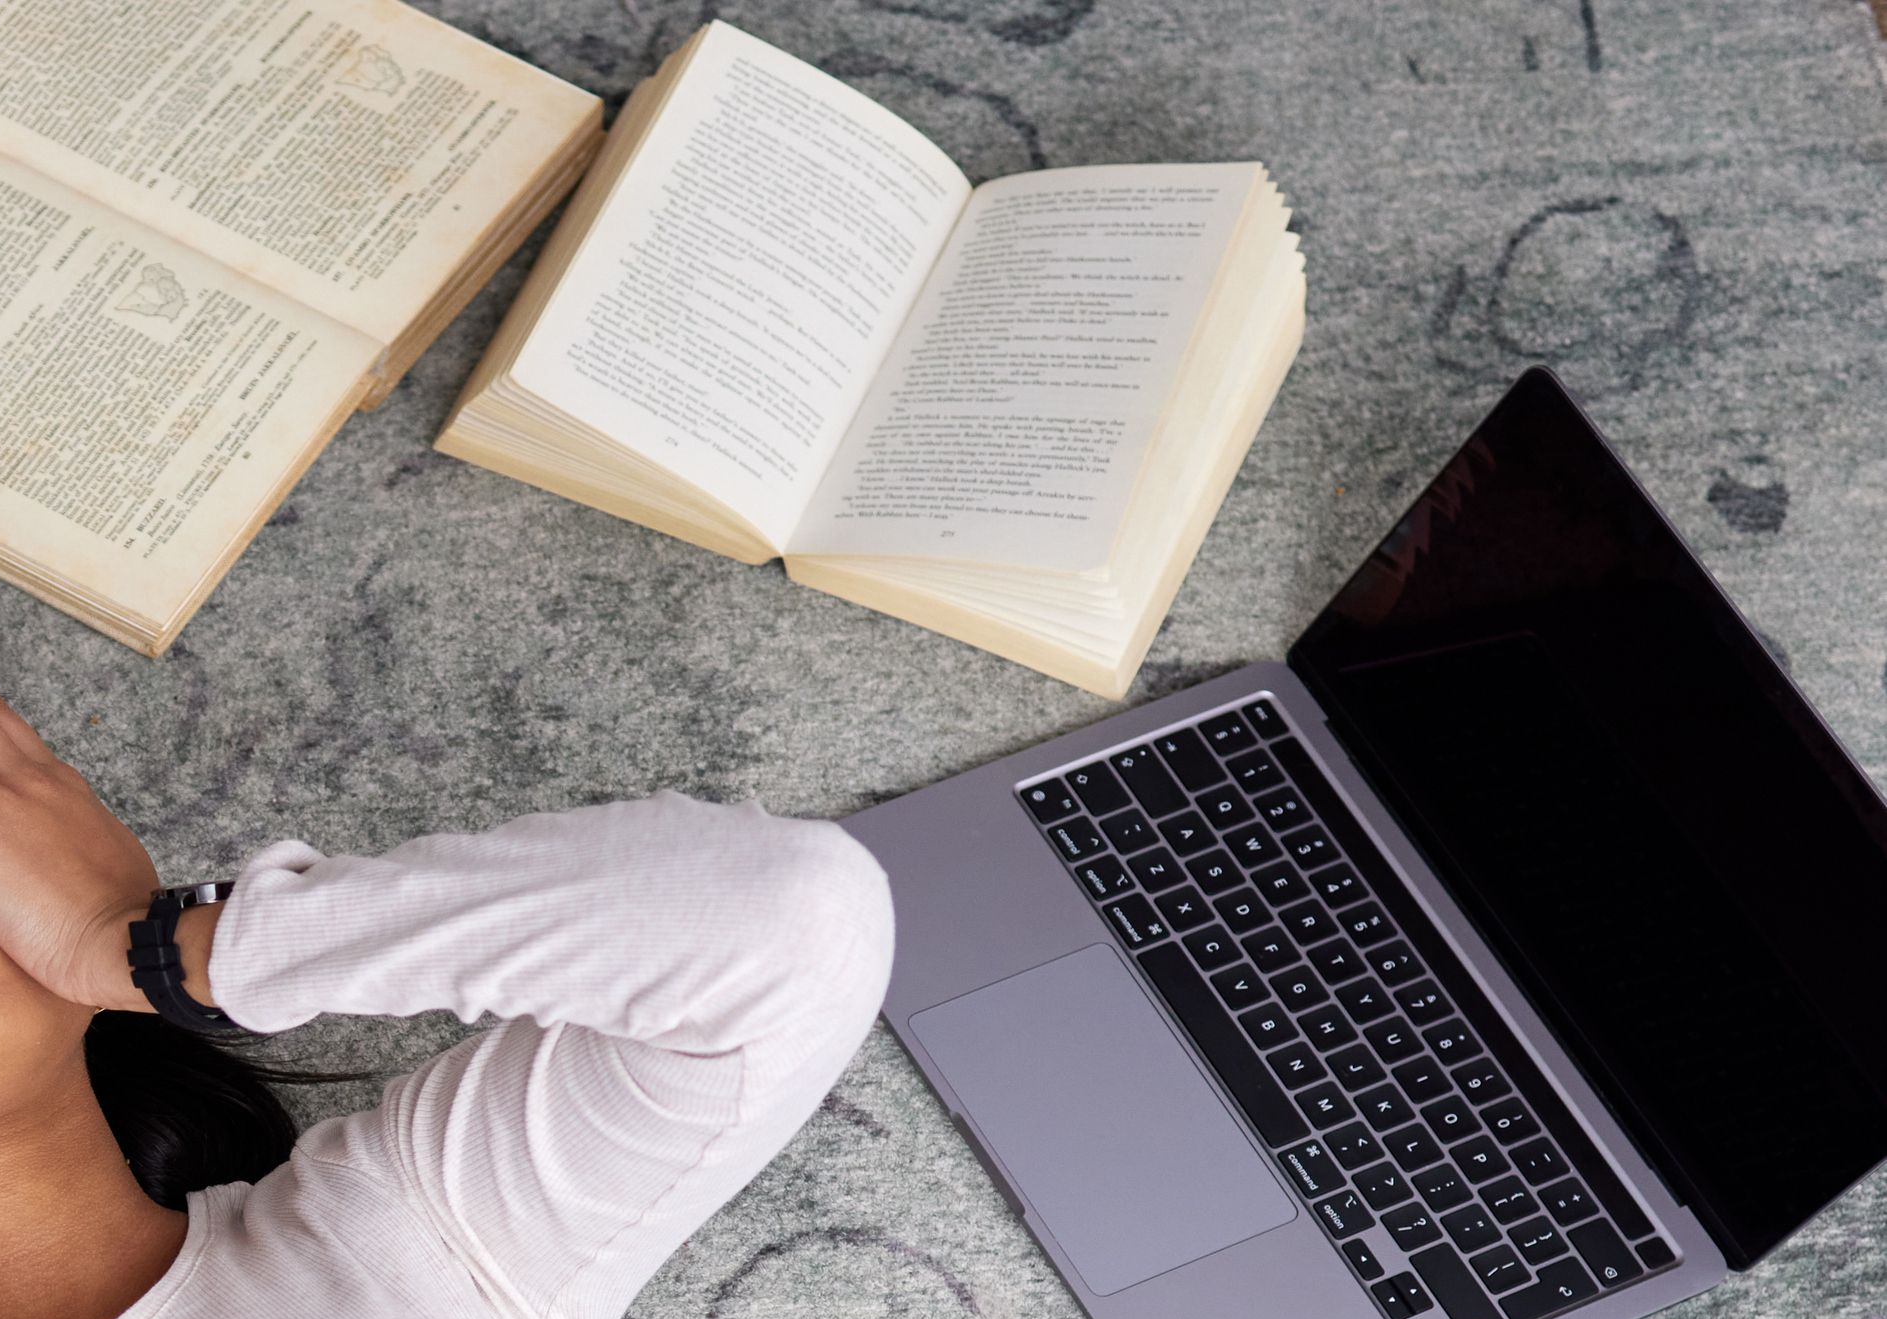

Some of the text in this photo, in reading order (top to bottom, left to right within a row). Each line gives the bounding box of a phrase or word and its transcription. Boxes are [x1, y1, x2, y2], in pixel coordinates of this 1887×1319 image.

[1244, 769, 1256, 778] 1
[1218, 801, 1233, 813] Q
[1269, 806, 1284, 817] 2
[1180, 829, 1194, 839] A
[1056, 827, 1081, 856] control
[1245, 837, 1262, 851] W
[1297, 844, 1312, 855] 3
[1149, 864, 1165, 875] Z
[1208, 866, 1223, 877] S
[1086, 869, 1107, 895] option
[1273, 877, 1288, 889] E
[1327, 884, 1340, 893] 4
[1177, 902, 1193, 914] X
[1235, 904, 1250, 916] D
[1112, 906, 1143, 944] command
[1301, 916, 1316, 928] R
[1354, 921, 1368, 932] 5
[1205, 942, 1220, 953] C
[1264, 943, 1279, 953] F
[1331, 954, 1345, 965] T
[1382, 960, 1396, 971] 6
[1234, 980, 1249, 990] V
[1292, 983, 1307, 994] G
[1359, 994, 1373, 1004] Y
[1411, 999, 1425, 1008] 7
[1261, 1019, 1276, 1031] B
[1320, 1021, 1335, 1034] H
[1387, 1033, 1402, 1045] U
[1439, 1038, 1453, 1049] 8
[1289, 1059, 1305, 1071] N
[1349, 1064, 1364, 1072] J
[1468, 1078, 1482, 1089] 9
[1317, 1098, 1334, 1112] M
[1377, 1100, 1392, 1113] K
[1406, 1141, 1419, 1152] L
[1472, 1153, 1487, 1163] P
[1287, 1153, 1319, 1191] command
[1323, 1203, 1345, 1230] option
